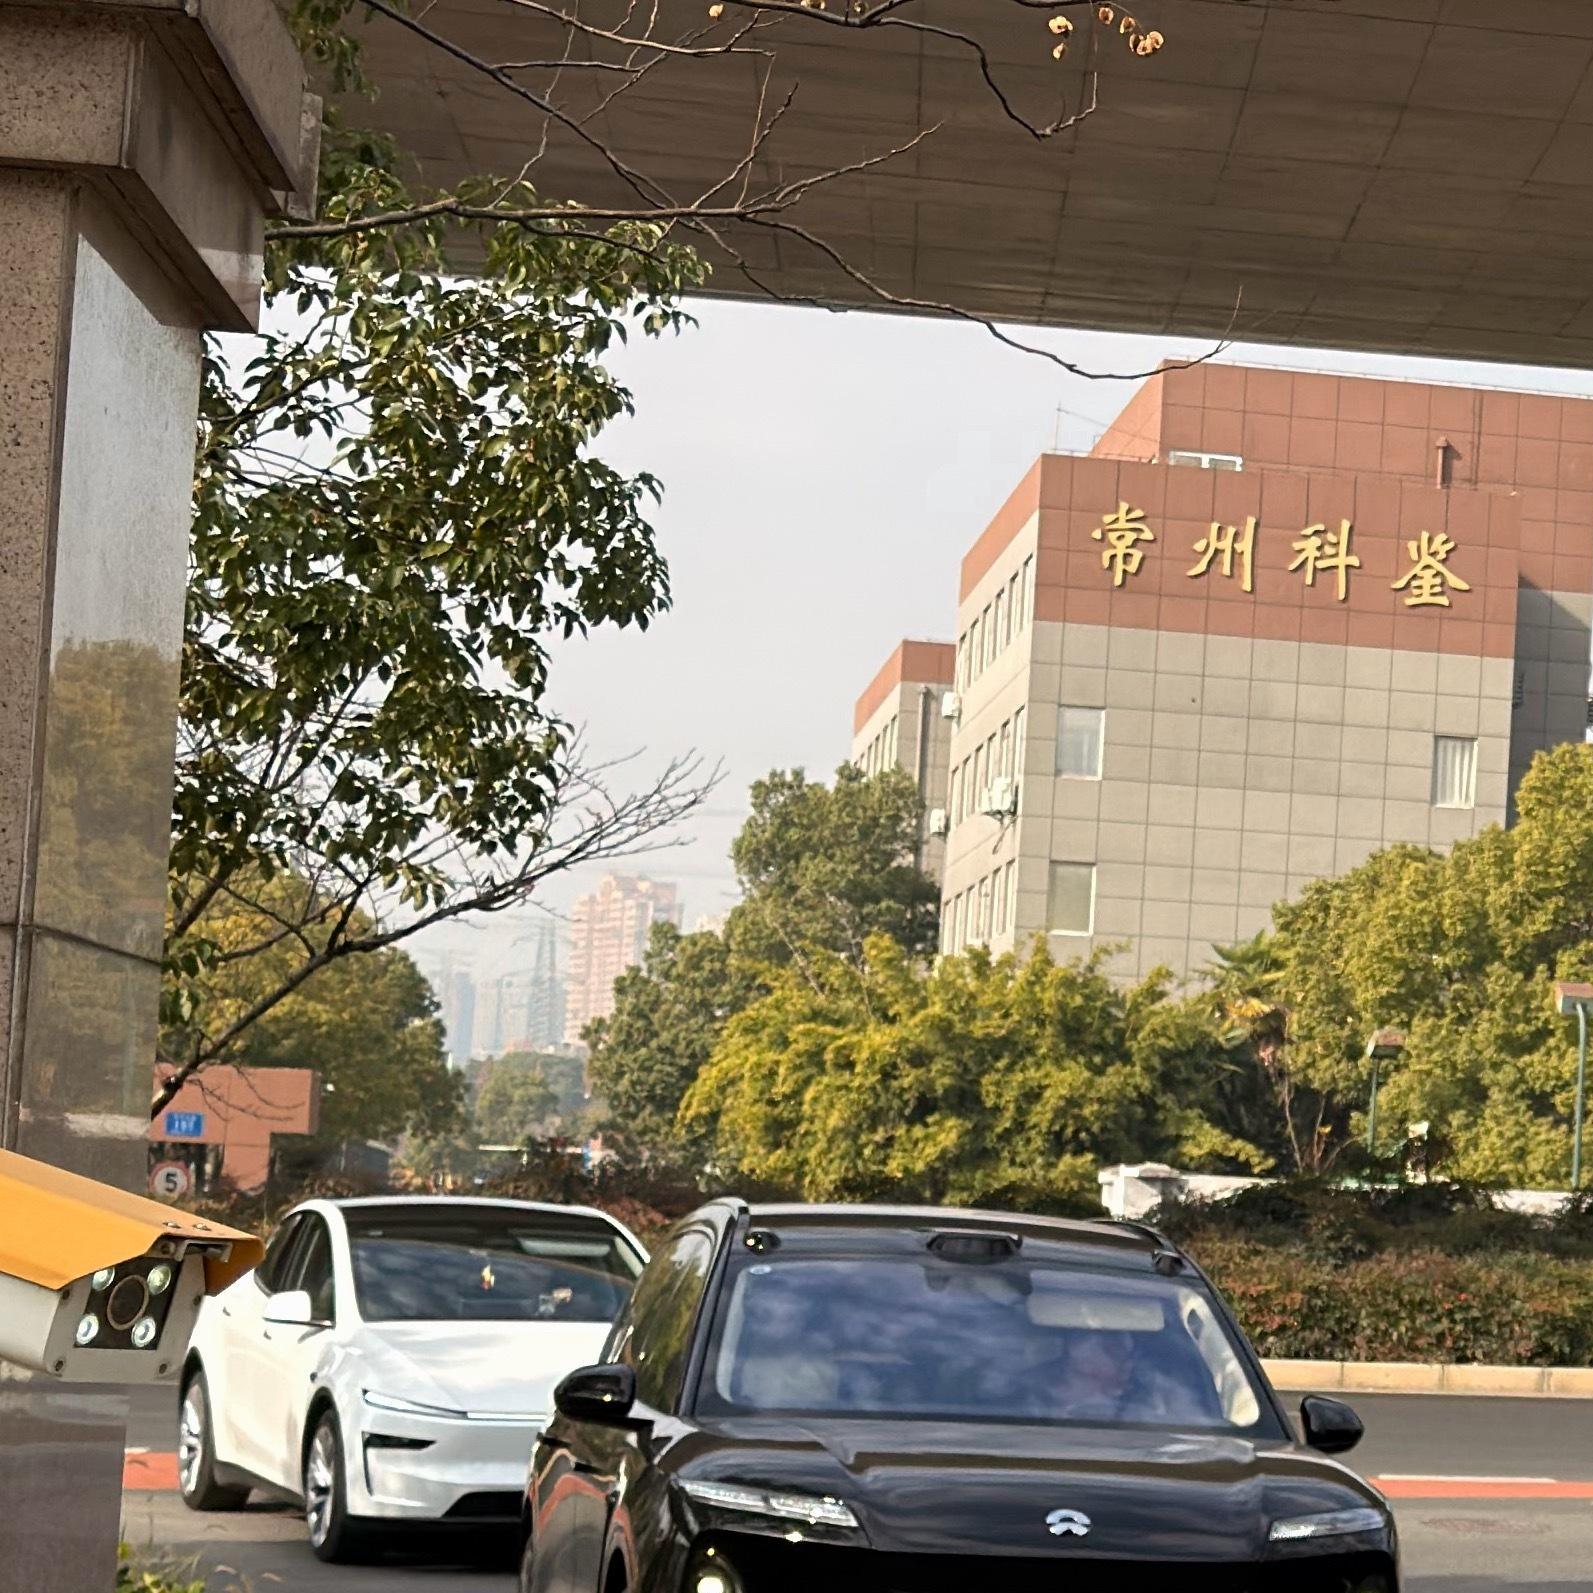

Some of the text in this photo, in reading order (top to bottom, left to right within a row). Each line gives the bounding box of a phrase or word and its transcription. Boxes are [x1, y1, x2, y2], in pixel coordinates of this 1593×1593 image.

[1091, 501, 1471, 607] 常州科鉴
[165, 1173, 178, 1192] 5
